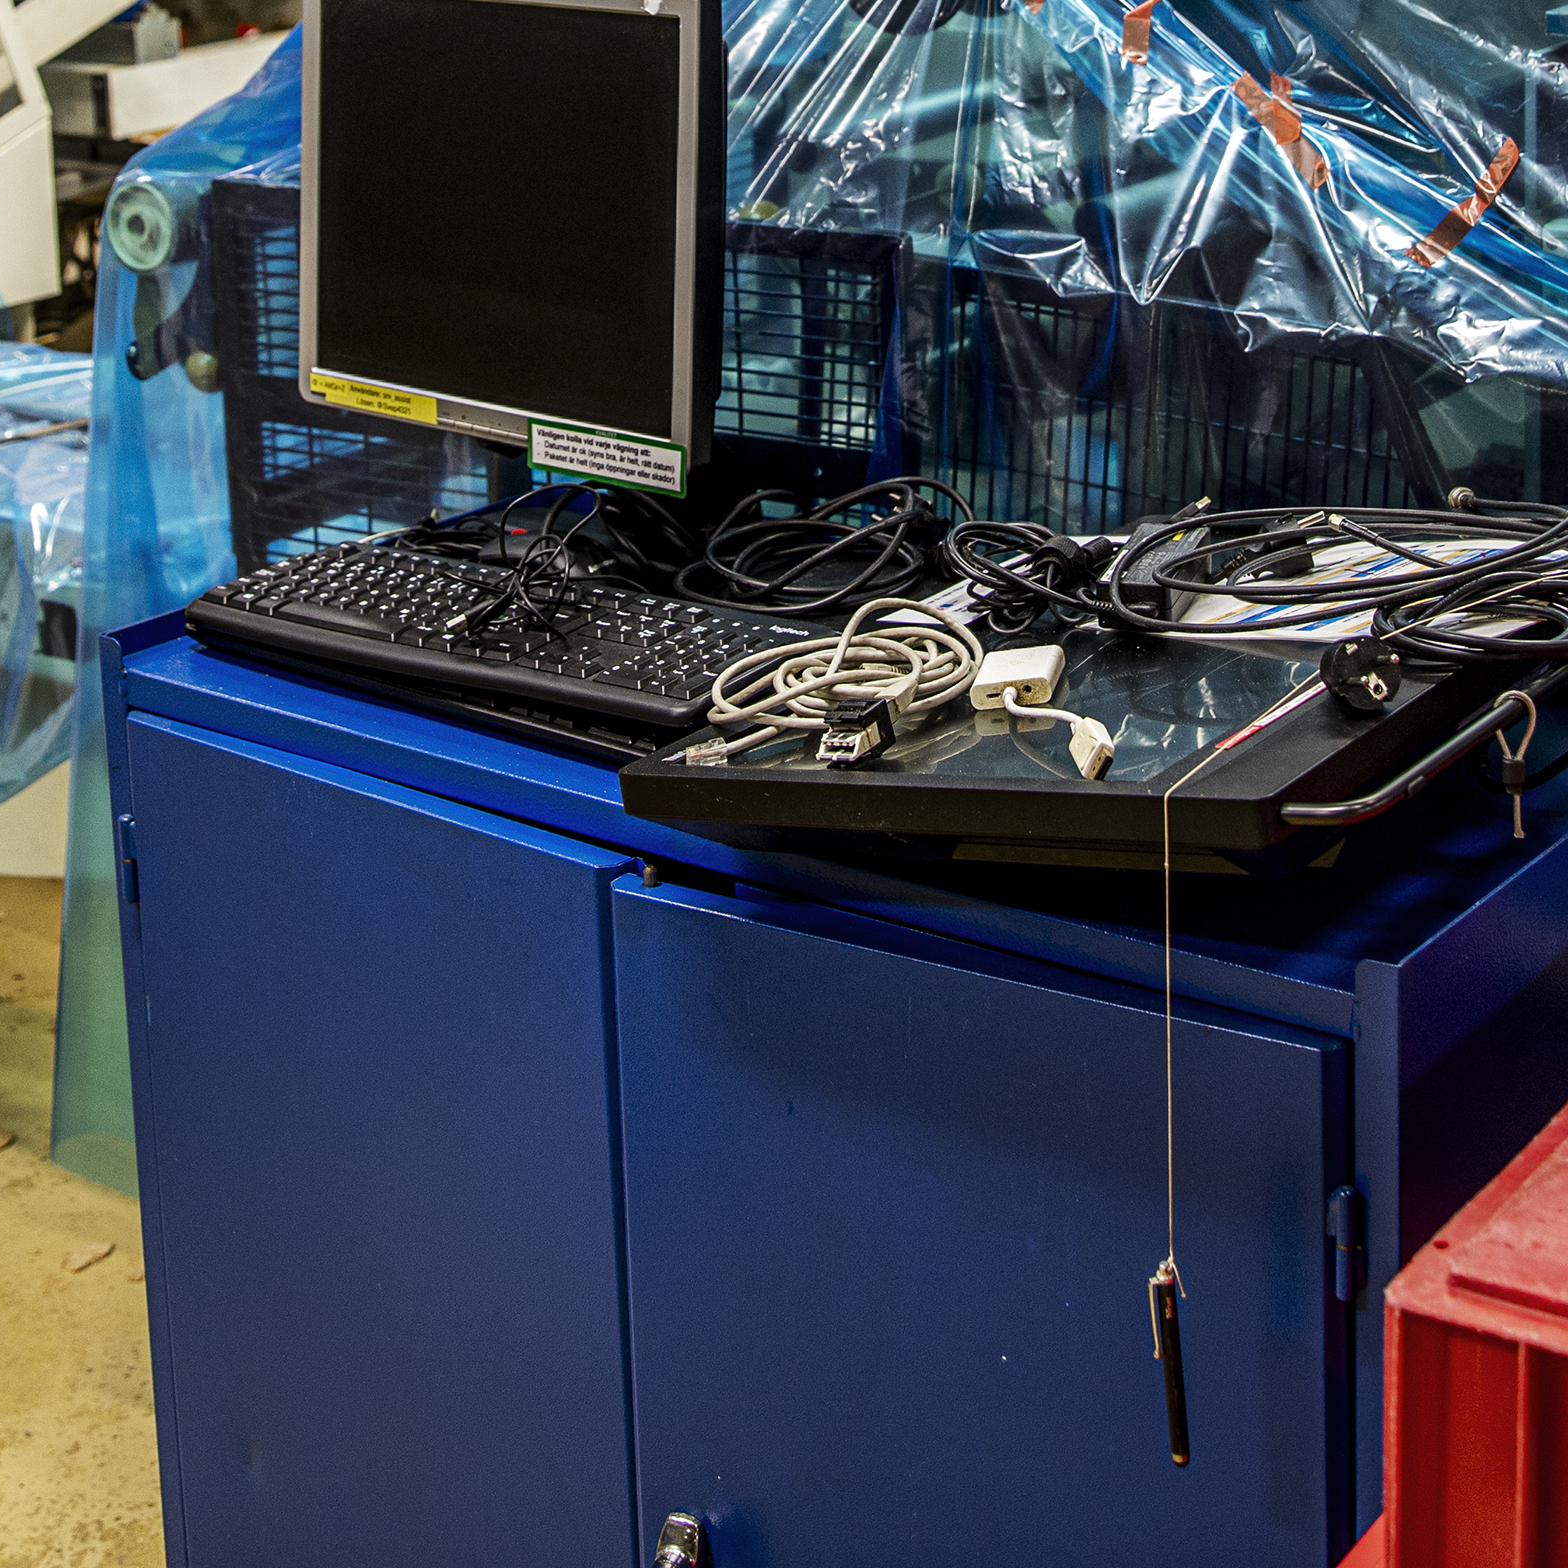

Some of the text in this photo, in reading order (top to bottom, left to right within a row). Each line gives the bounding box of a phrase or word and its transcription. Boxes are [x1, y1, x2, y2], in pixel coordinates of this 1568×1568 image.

[536, 428, 565, 441] Vänligen
[566, 433, 582, 444] kolla
[583, 436, 594, 446] vid
[595, 440, 611, 450] varje
[612, 443, 638, 456] vägning
[544, 440, 570, 453] Datumet
[588, 449, 604, 460] (syns
[653, 461, 675, 474] datum)
[544, 451, 568, 462] Paketet
[576, 457, 588, 466] helt
[589, 459, 605, 470] (inga
[606, 462, 636, 476] öppningar
[637, 469, 651, 480] eller
[652, 471, 675, 485] skador)
